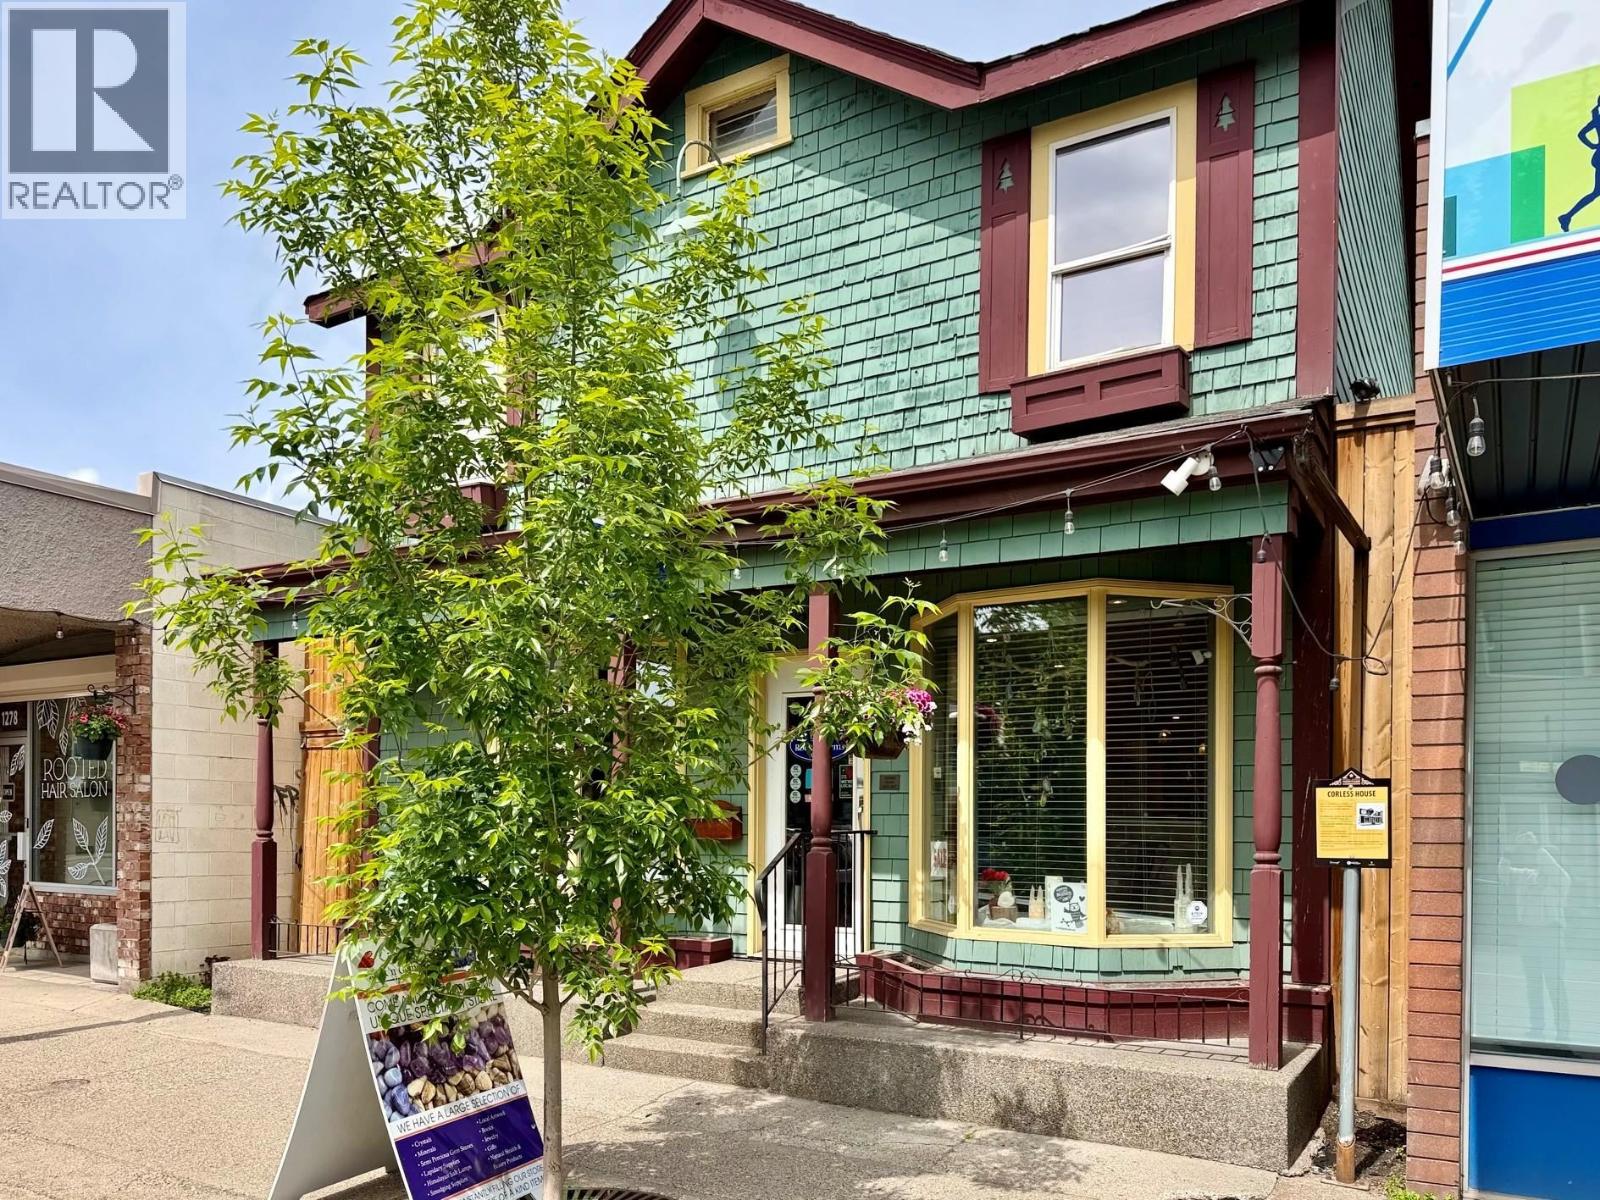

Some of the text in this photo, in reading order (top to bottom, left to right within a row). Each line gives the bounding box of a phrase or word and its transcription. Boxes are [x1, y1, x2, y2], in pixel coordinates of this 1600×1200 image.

[1, 710, 18, 726] 1278
[43, 757, 108, 781] ROOTED
[41, 780, 108, 799] HAIR SALON
[1327, 790, 1354, 798] CORLESS
[396, 1084, 520, 1133] WE HAVE A LARGE SELECTION OF
